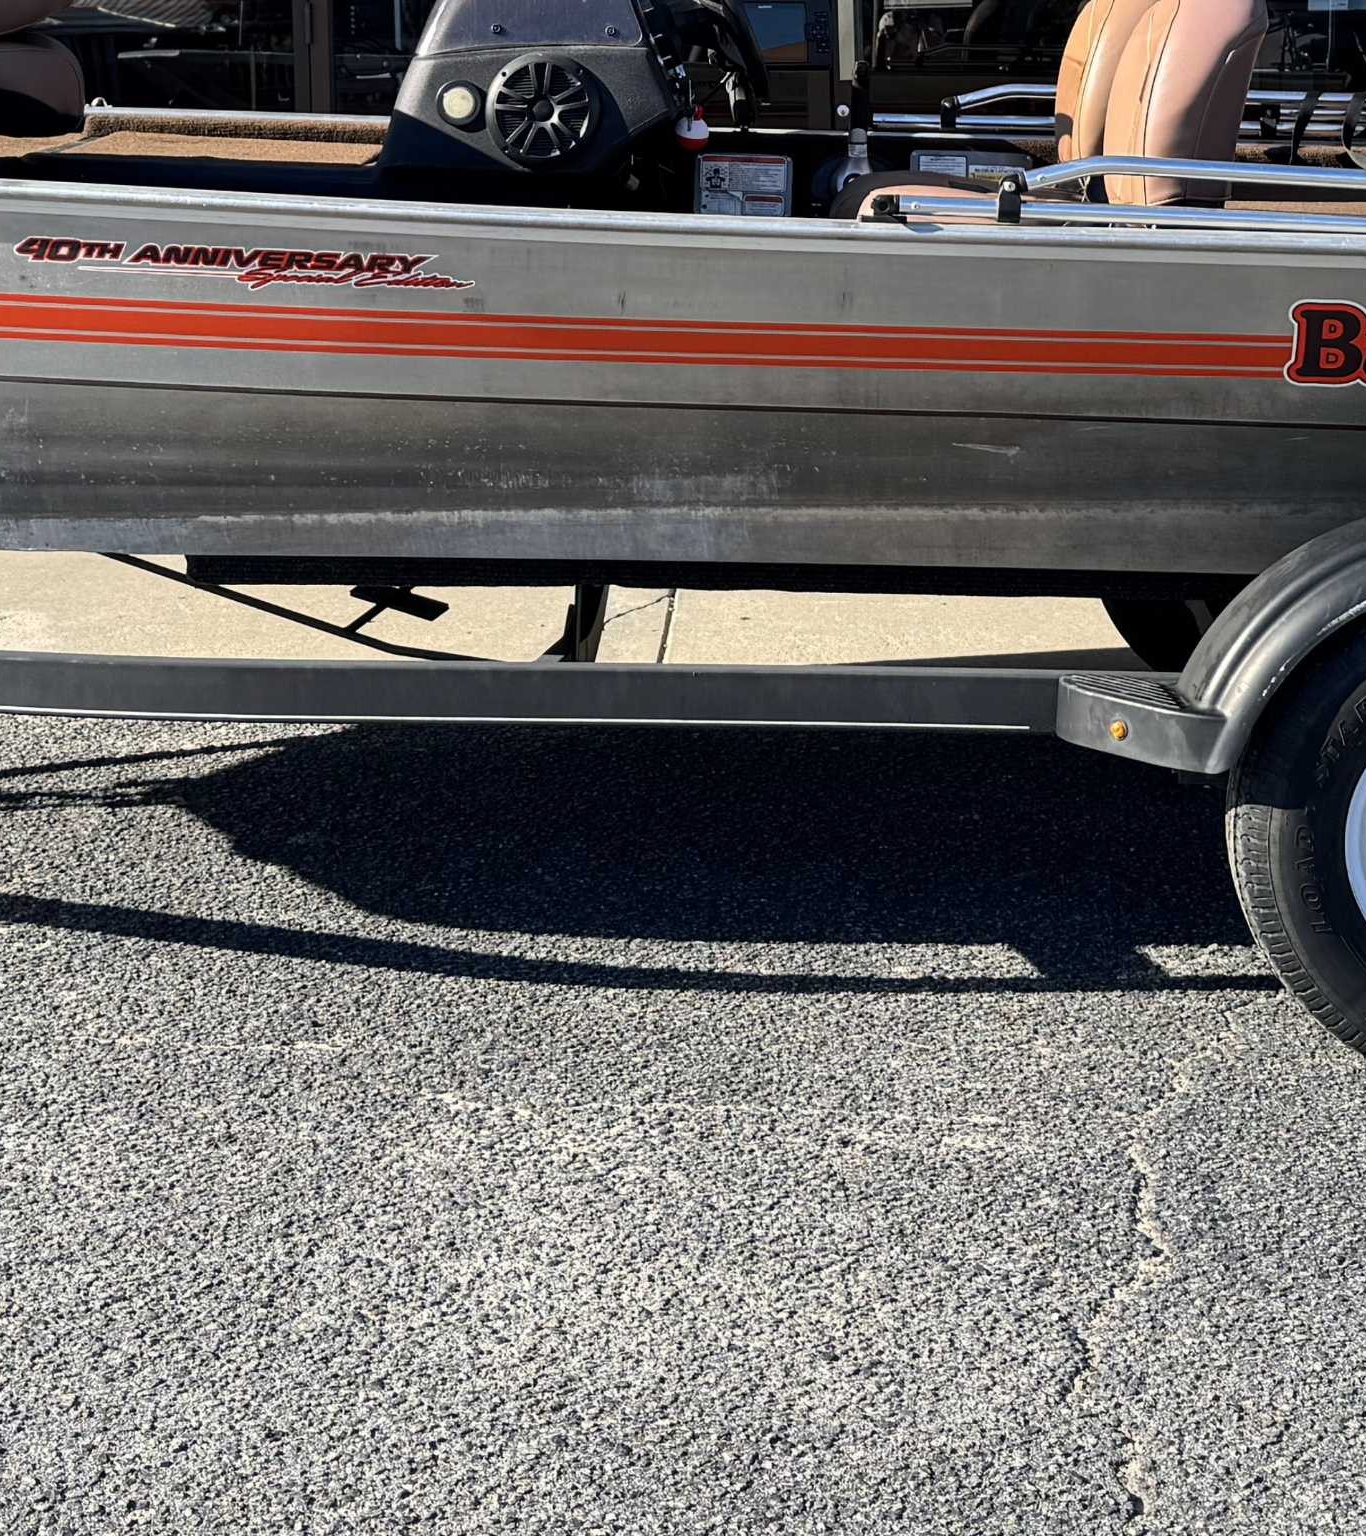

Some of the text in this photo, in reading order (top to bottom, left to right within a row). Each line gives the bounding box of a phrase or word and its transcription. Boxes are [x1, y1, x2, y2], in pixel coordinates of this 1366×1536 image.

[13, 236, 440, 276] 40TH ANNIVERSARY
[235, 267, 355, 291] Special
